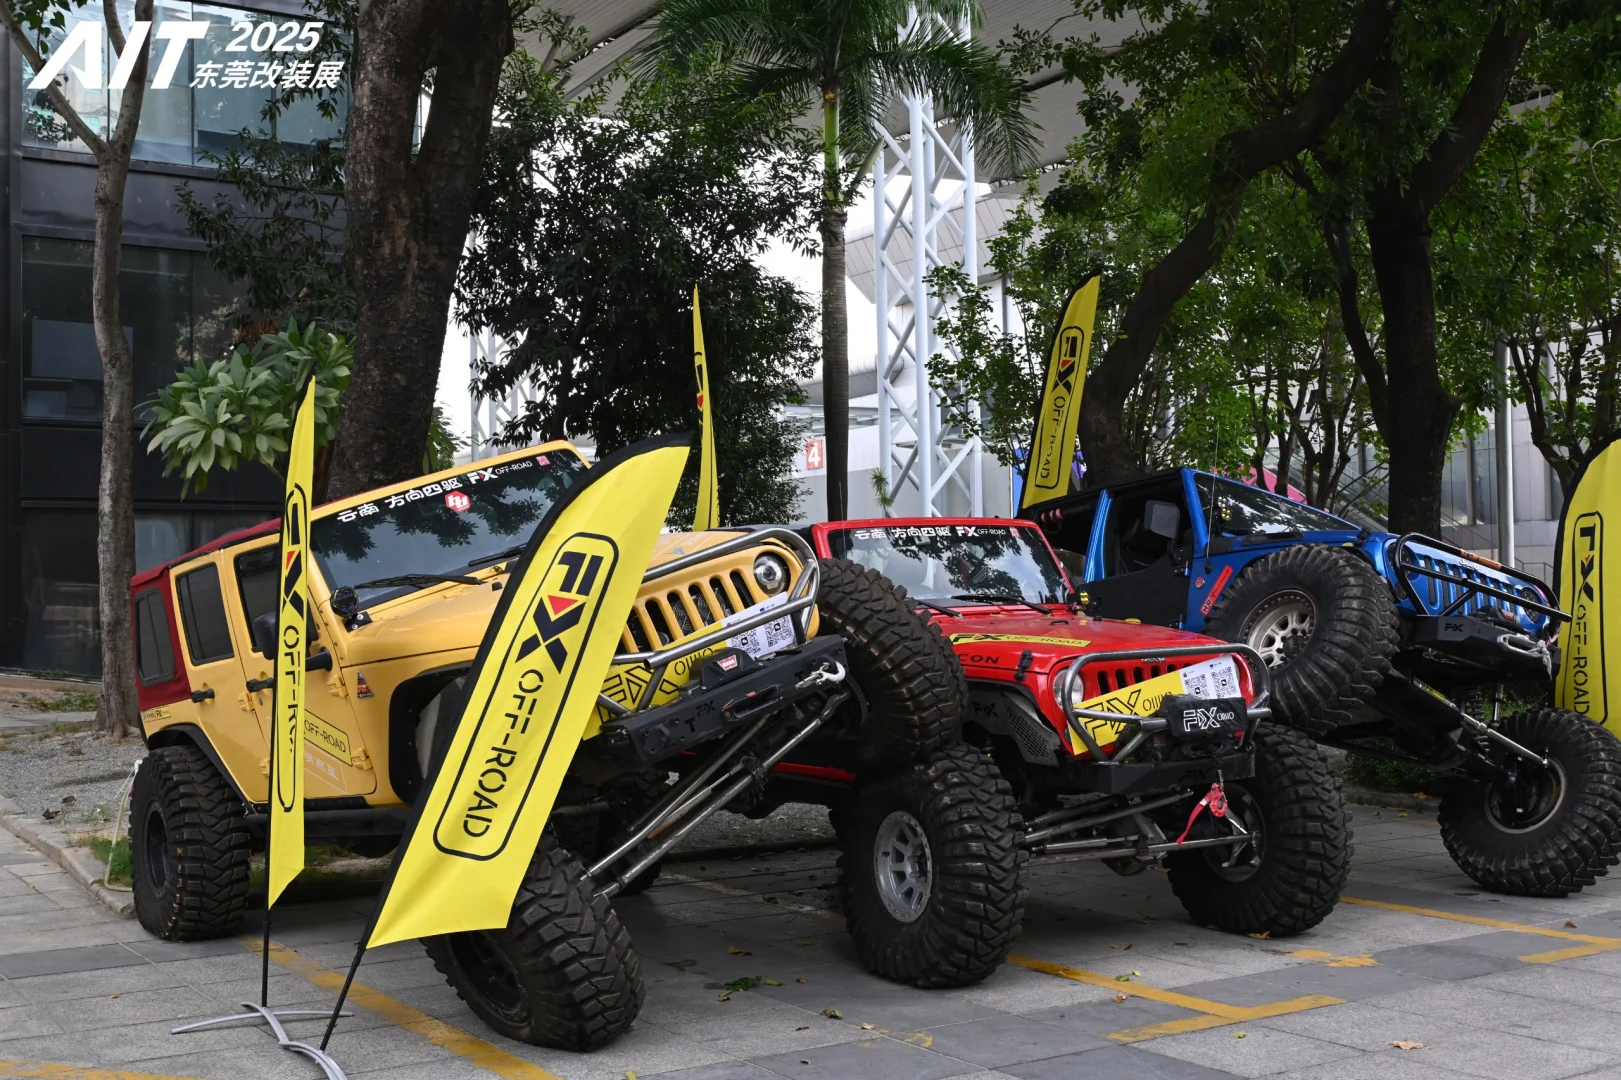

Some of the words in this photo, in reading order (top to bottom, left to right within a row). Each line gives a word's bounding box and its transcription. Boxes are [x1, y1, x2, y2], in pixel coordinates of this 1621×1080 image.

[808, 441, 821, 467] 4
[336, 502, 380, 523] 云南
[384, 477, 463, 509] 方向四驱
[468, 467, 499, 485] FX
[494, 460, 533, 476] OFF-ROAD
[854, 527, 888, 540] 云南
[955, 526, 979, 537] FX
[977, 528, 1007, 536] OFF-ROAD
[515, 551, 605, 675] FX
[1006, 635, 1083, 645] OFF-ROAD
[1572, 604, 1590, 715] OFF-ROAD
[1183, 706, 1221, 731] FX
[303, 719, 347, 753] OFF-ROAD
[463, 668, 545, 838] OFF-ROAD
